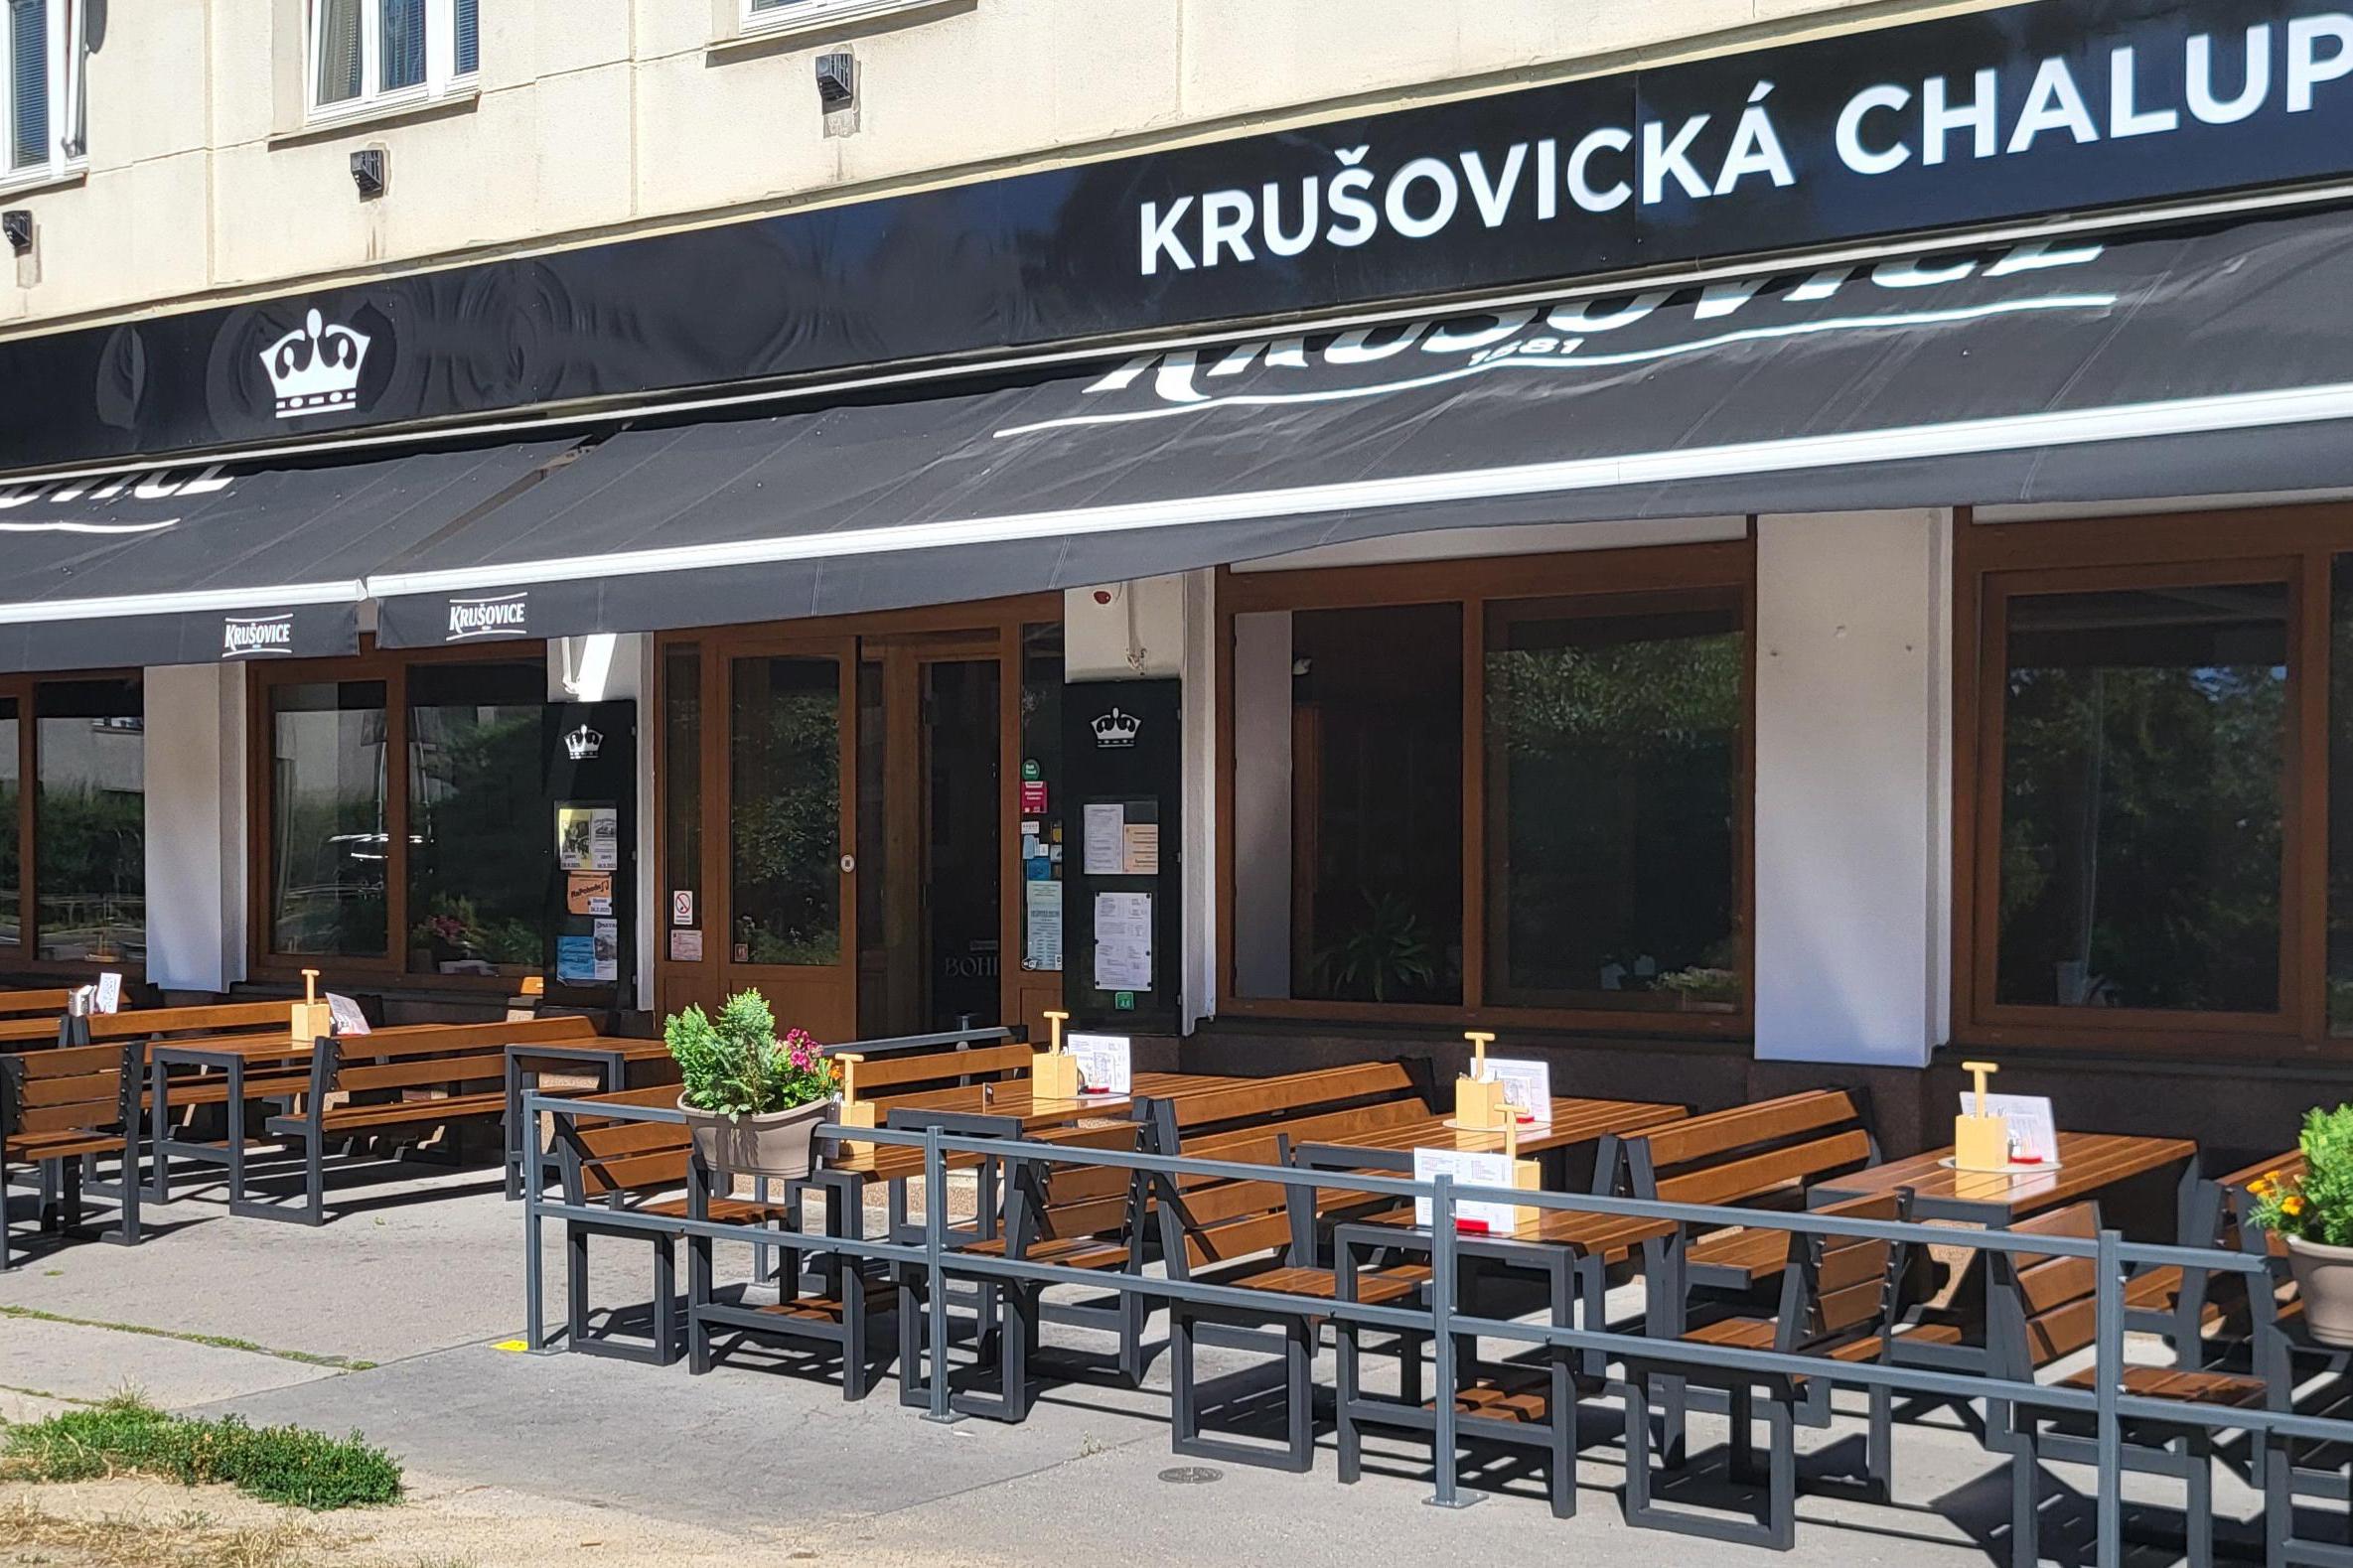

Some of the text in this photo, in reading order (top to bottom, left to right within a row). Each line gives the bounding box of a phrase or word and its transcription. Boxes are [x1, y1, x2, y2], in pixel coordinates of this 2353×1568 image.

[1140, 13, 2353, 275] KRUŠOVICKÁ CHALUP
[448, 603, 526, 635] KRUŠOVICE
[223, 623, 292, 651] KRUŠOVICE
